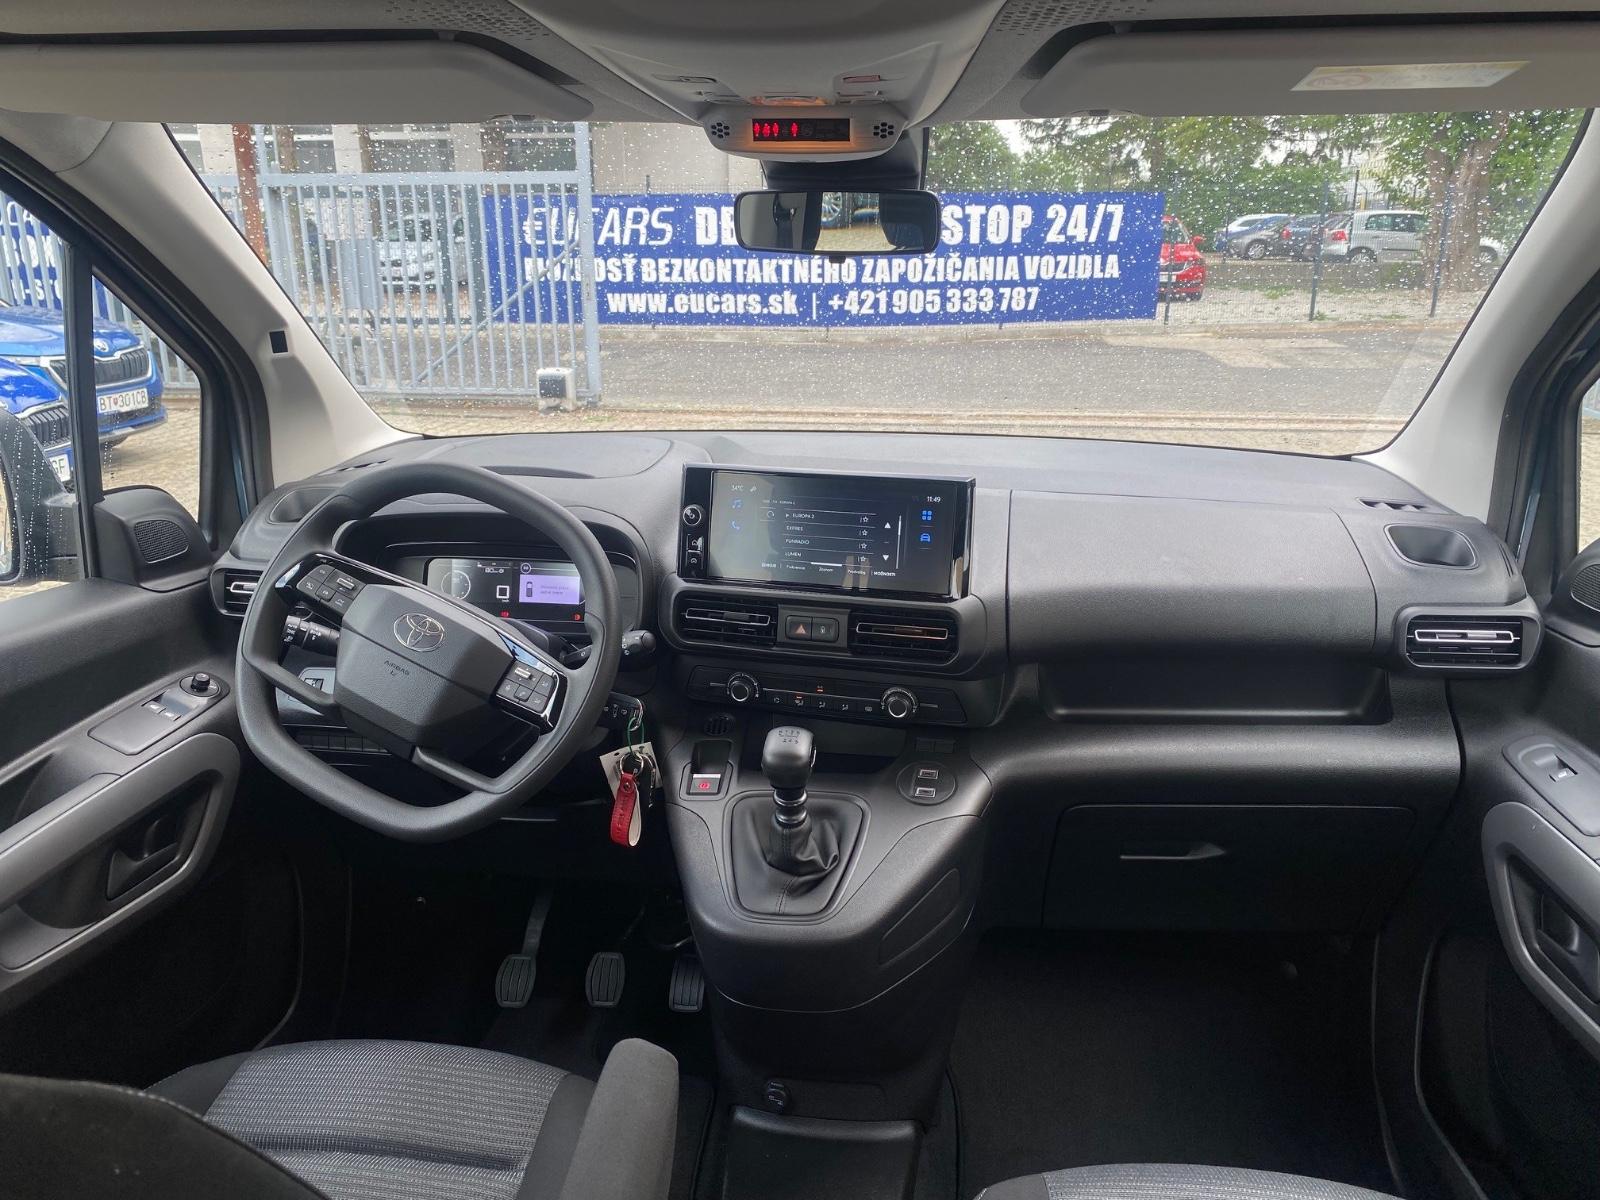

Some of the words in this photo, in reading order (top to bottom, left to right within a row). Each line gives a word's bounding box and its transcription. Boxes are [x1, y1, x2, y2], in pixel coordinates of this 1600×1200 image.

[694, 206, 735, 246] DE
[941, 204, 1033, 245] STOP
[1046, 203, 1124, 244] 24/7
[641, 255, 857, 284] BEZKONTAKTNÉHO
[861, 252, 1020, 284] ZAPOŽIČANIA
[1025, 254, 1120, 280] VOZIDLA
[607, 290, 799, 315] www.eucars.sk
[828, 291, 887, 315] +421
[892, 290, 940, 314] 905
[946, 288, 994, 313] 333
[999, 286, 1040, 311] 787
